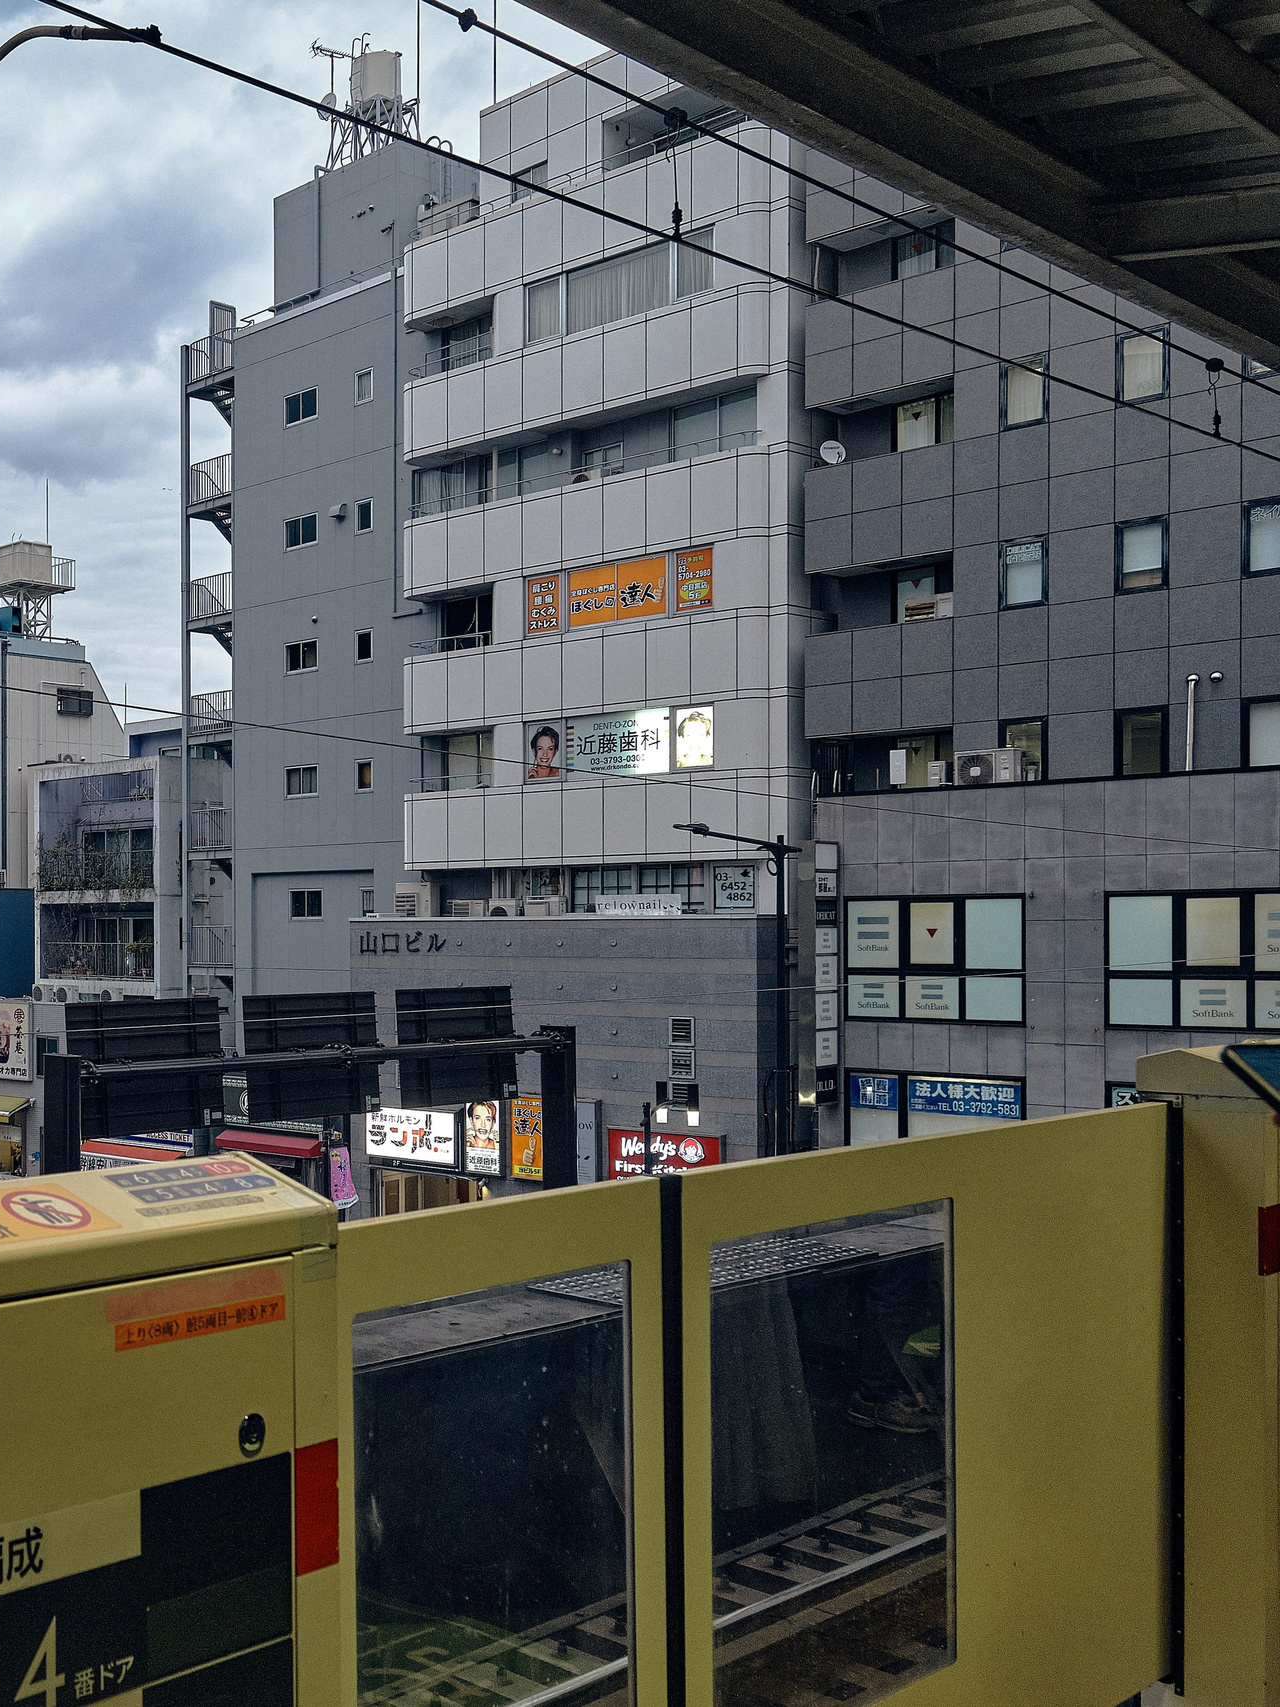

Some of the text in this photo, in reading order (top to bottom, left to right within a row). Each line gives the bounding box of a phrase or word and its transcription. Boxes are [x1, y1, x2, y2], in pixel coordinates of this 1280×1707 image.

[531, 606, 556, 618] むくみ
[530, 618, 557, 630] ストレス
[576, 728, 661, 756] 近藤歯科
[726, 892, 753, 901] 4862
[360, 931, 447, 955] 山口ビル
[915, 1003, 950, 1011] SoftBank
[1192, 1010, 1235, 1018] SoftBank
[915, 1082, 1015, 1102] 法人様大歓迎
[938, 1100, 1020, 1116] TEL 03-3792-5831
[371, 1112, 421, 1125] 新鮮ホルモン
[170, 1132, 190, 1142] TICKET
[205, 1163, 231, 1174] 10
[134, 1173, 148, 1184] 6
[179, 1168, 193, 1178] 4
[157, 1188, 173, 1200] 5
[204, 1183, 218, 1193] 4
[14, 1615, 66, 1707] 4
[74, 1655, 135, 1700] 番ドア
